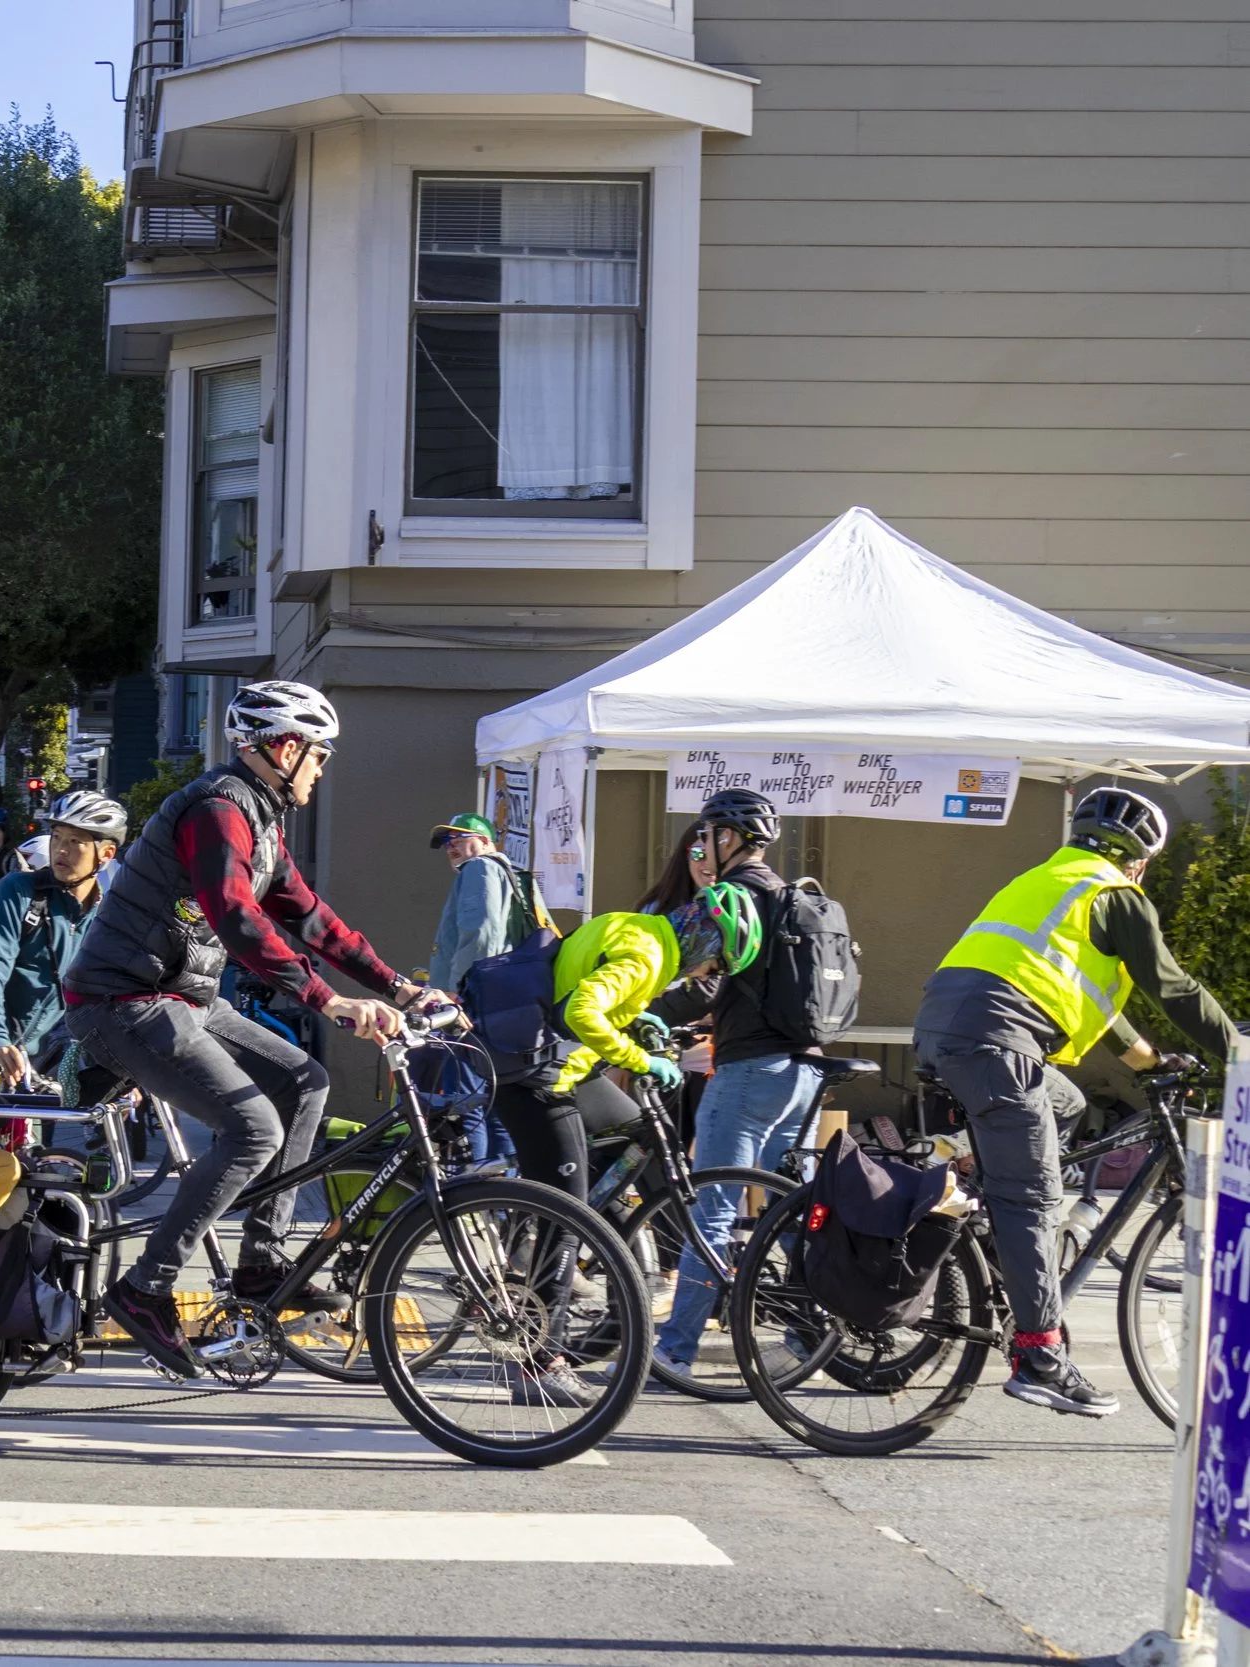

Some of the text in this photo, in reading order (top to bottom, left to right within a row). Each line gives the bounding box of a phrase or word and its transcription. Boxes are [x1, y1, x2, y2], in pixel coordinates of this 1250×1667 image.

[687, 751, 721, 762] BIKE
[771, 752, 806, 765] BIKE
[858, 754, 893, 768] BIKE
[708, 760, 726, 775] TO
[793, 763, 811, 777] TO
[879, 767, 897, 781] TO
[674, 772, 752, 790] WHEREVER
[760, 774, 835, 792] WHEREVER
[843, 780, 923, 794] WHEREVER
[787, 789, 816, 804] DAY
[870, 794, 902, 807] DAY
[969, 803, 1003, 813] SFMTA
[345, 1153, 402, 1223] XTRACYCLE
